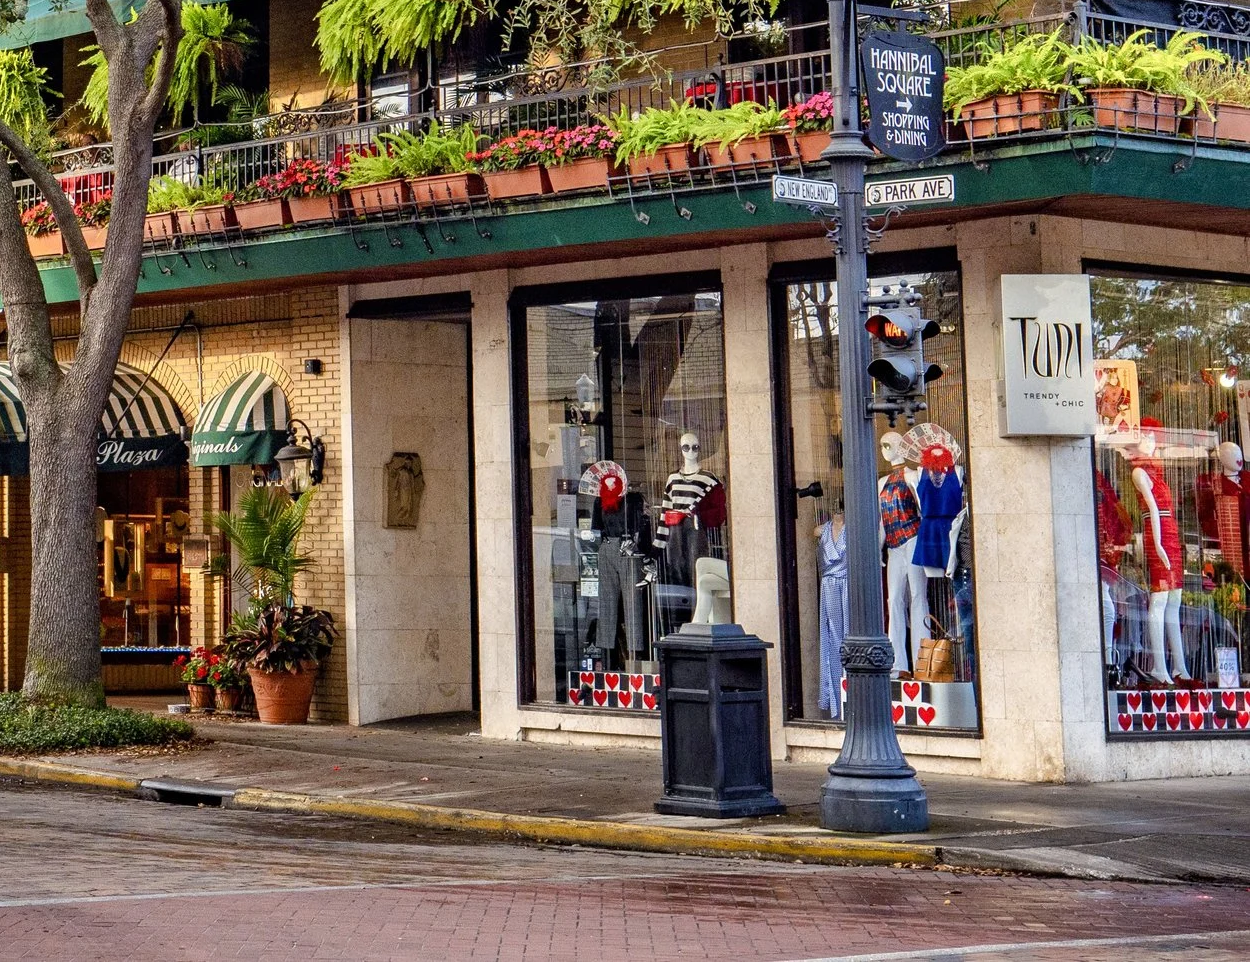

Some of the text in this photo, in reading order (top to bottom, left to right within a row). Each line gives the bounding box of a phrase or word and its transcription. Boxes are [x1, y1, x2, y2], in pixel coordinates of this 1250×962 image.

[870, 47, 937, 75] HANNIBAL
[876, 71, 933, 98] SQUARE
[882, 111, 930, 131] SHOPPING
[787, 181, 800, 198] NEW
[802, 183, 829, 201] ENGLAND
[885, 180, 946, 202] PARK AVE
[96, 440, 164, 465] Plaza
